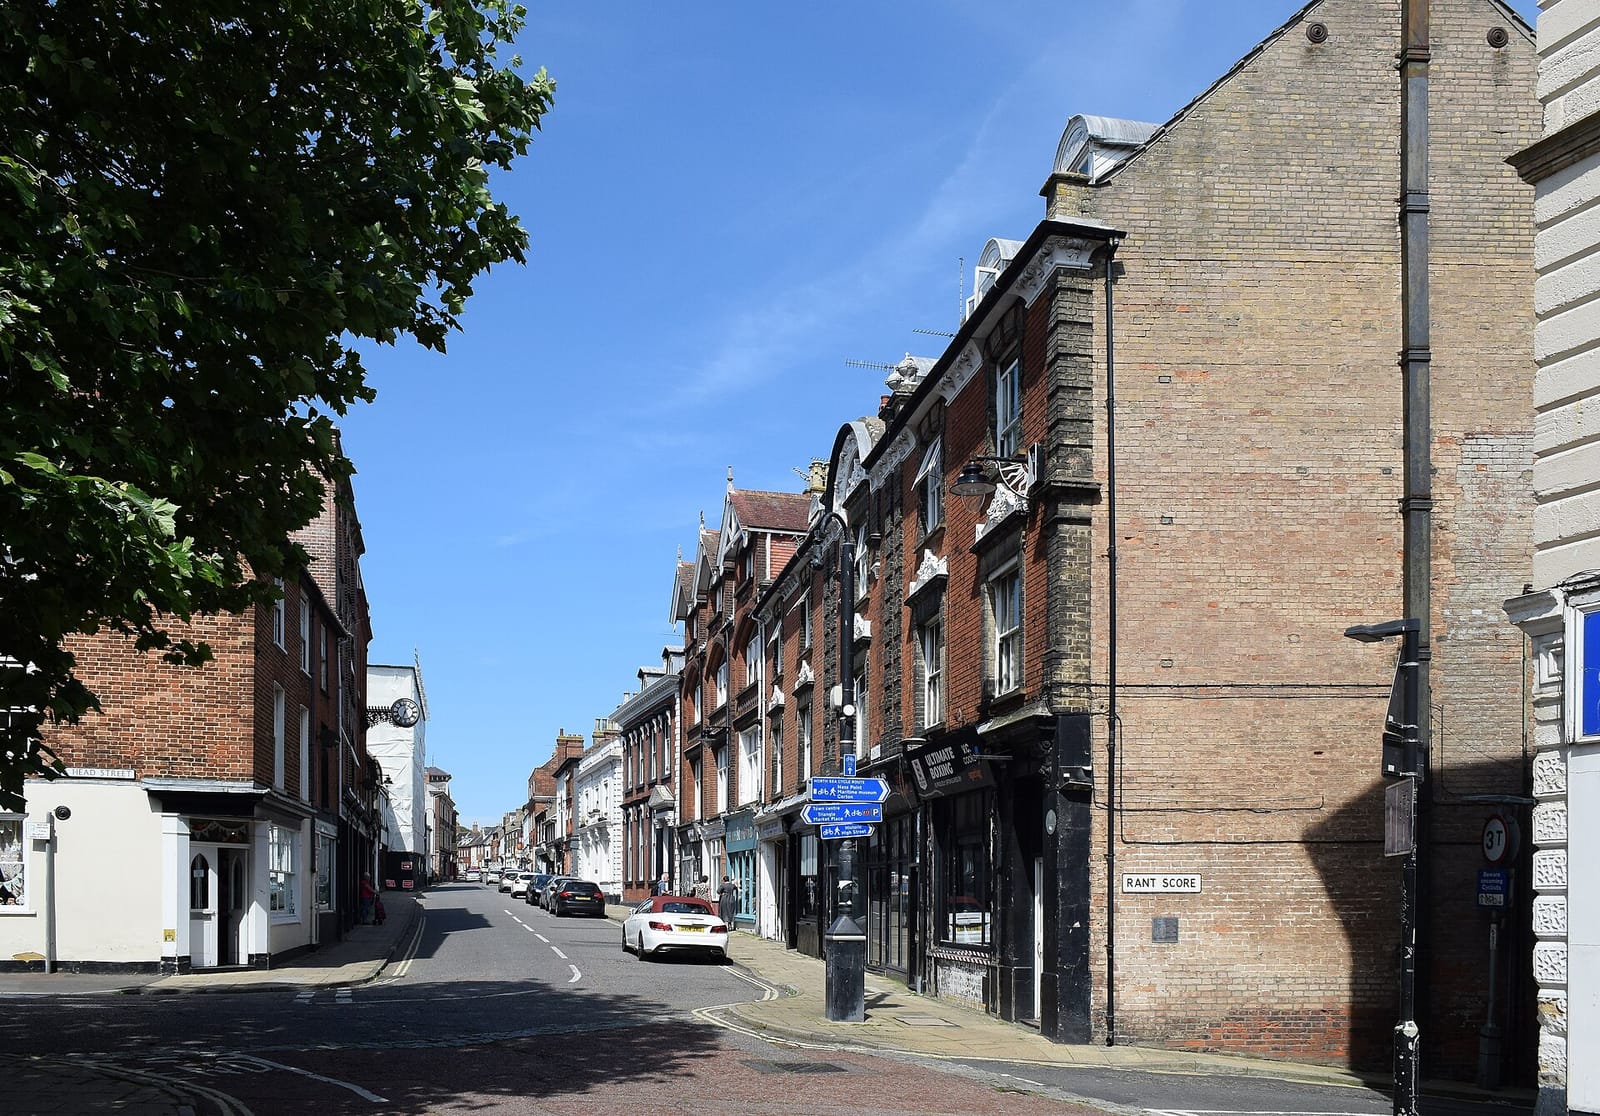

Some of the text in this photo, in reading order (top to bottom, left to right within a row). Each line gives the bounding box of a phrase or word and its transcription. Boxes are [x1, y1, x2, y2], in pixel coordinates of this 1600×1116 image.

[924, 746, 955, 767] ULTIMATE
[72, 768, 96, 776] HEAD
[928, 762, 954, 780] BOXING
[873, 808, 879, 816] P
[1126, 877, 1196, 888] RANT SCORE
